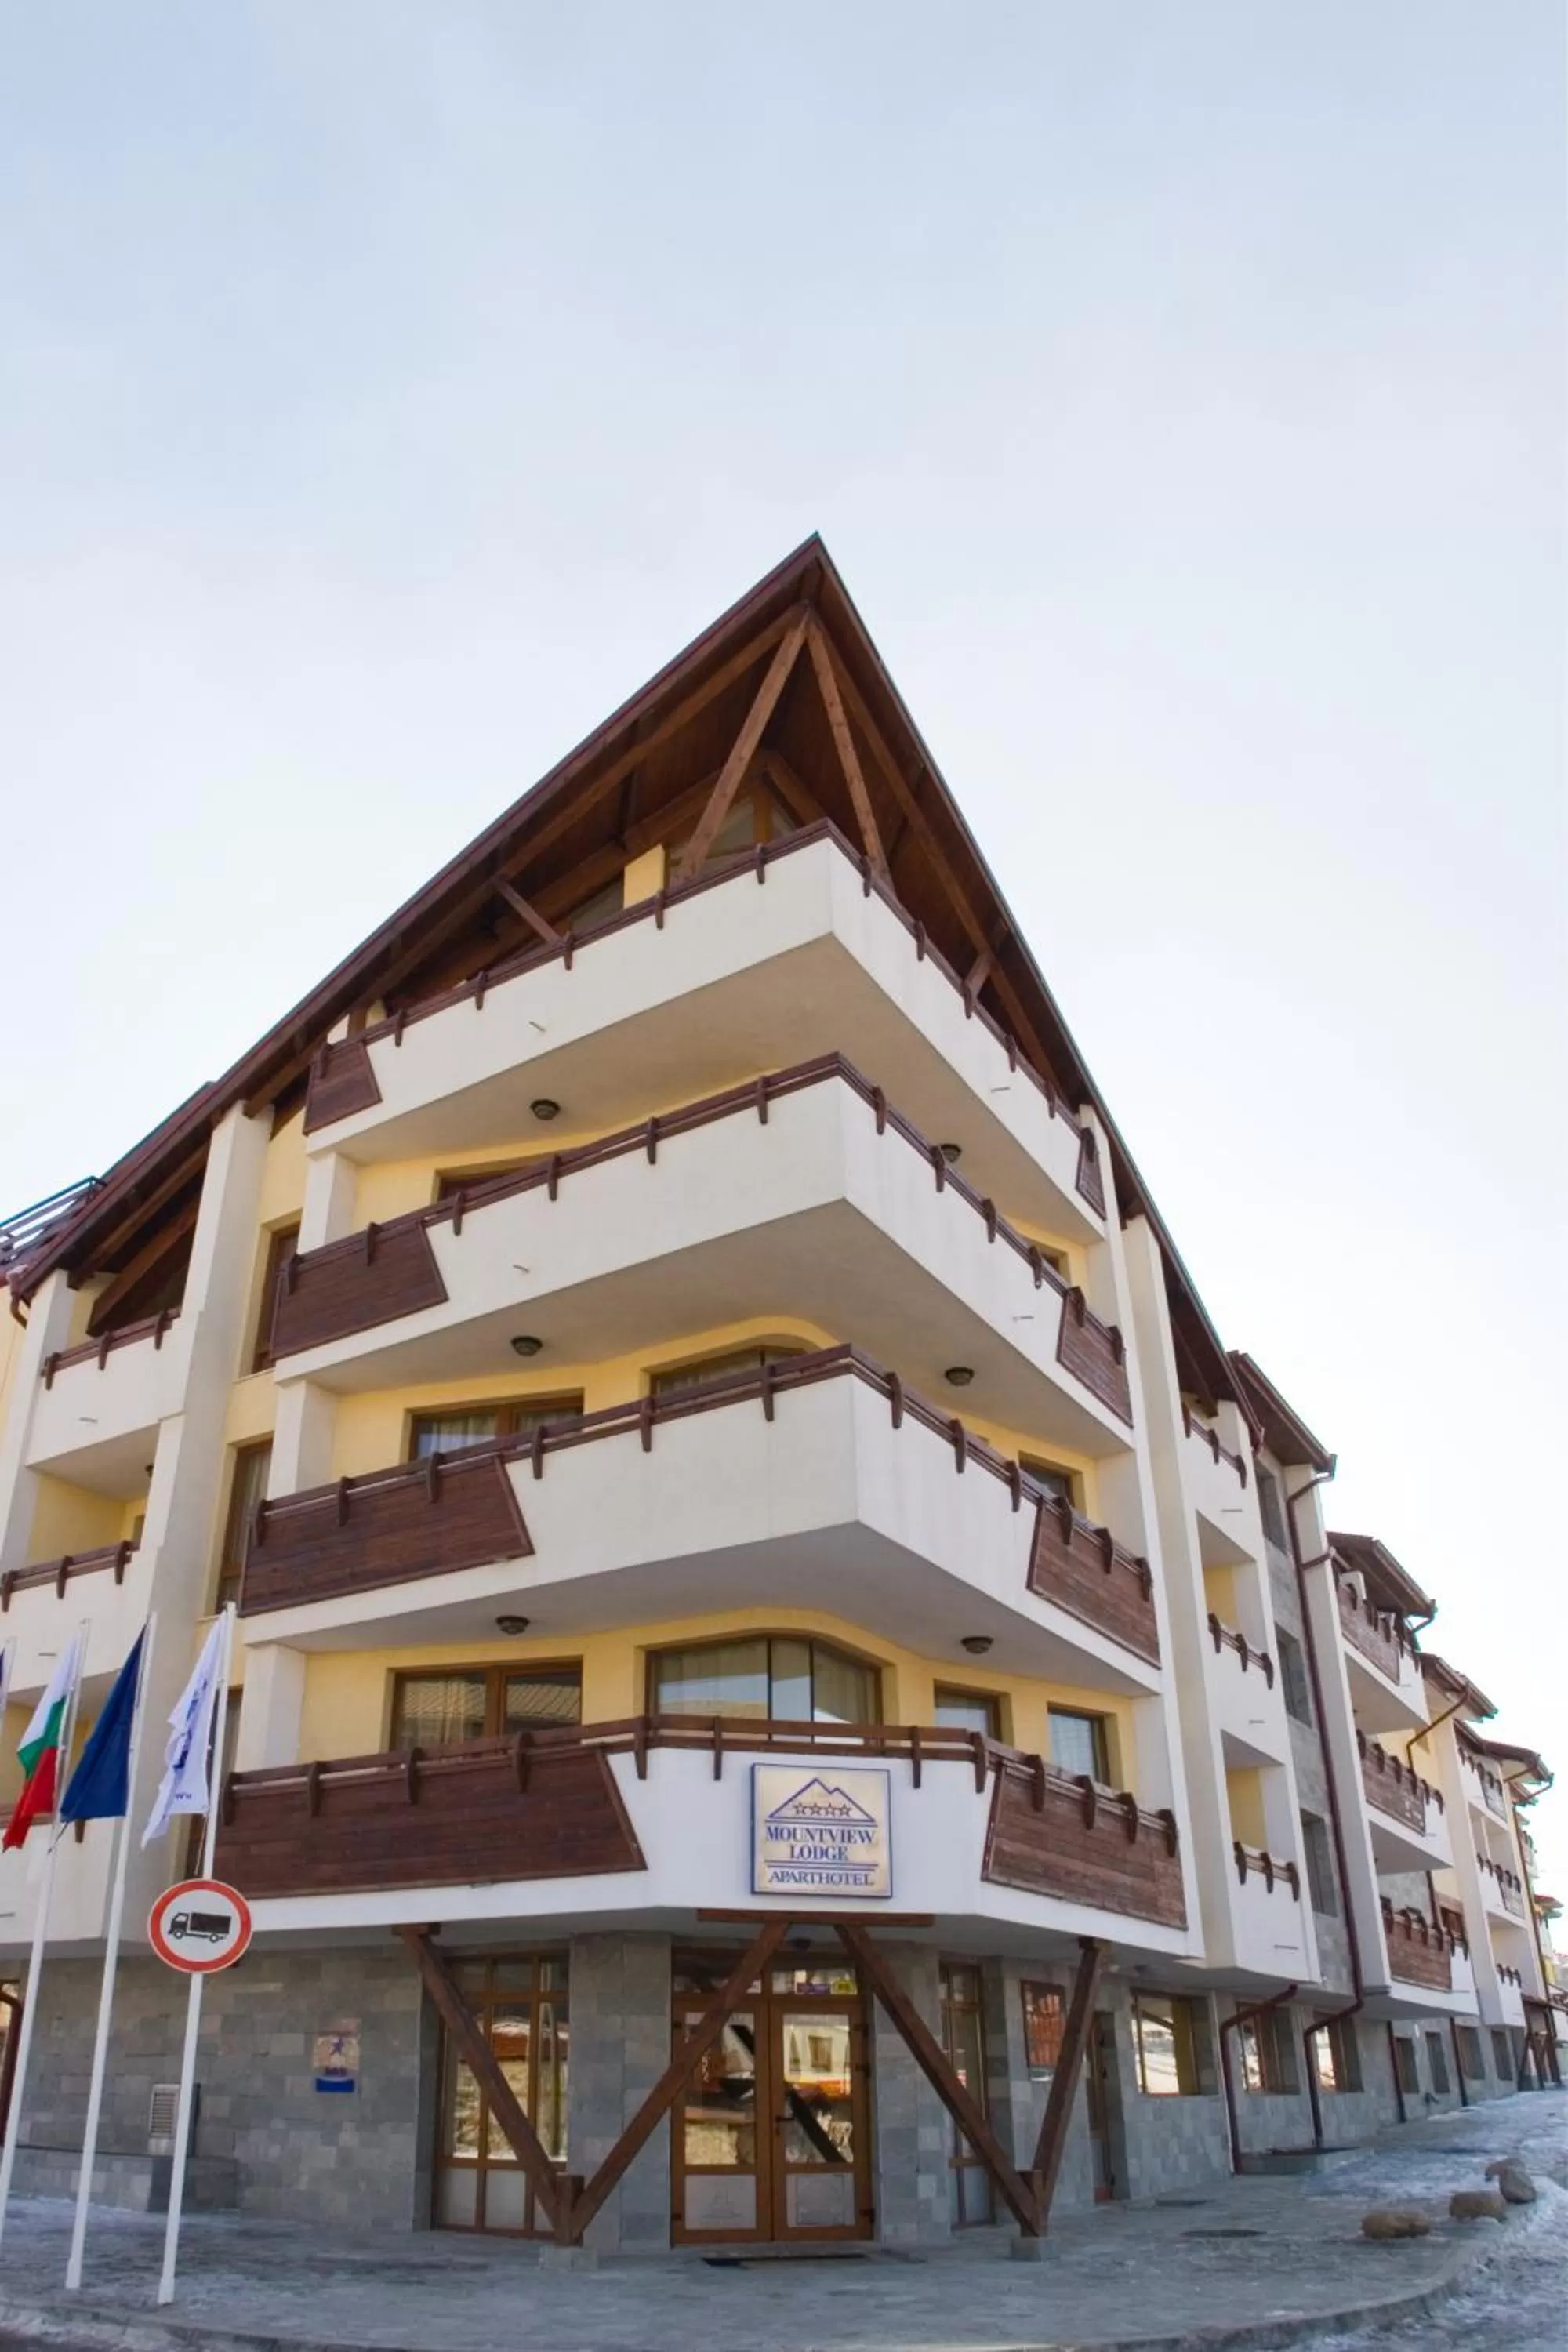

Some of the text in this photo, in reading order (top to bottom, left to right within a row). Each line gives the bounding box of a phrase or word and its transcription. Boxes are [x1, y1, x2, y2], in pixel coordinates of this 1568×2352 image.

[767, 1826, 874, 1844] MOUNTVIEW
[789, 1845, 848, 1861] LODGE
[769, 1871, 874, 1885] APARTHOTEL
